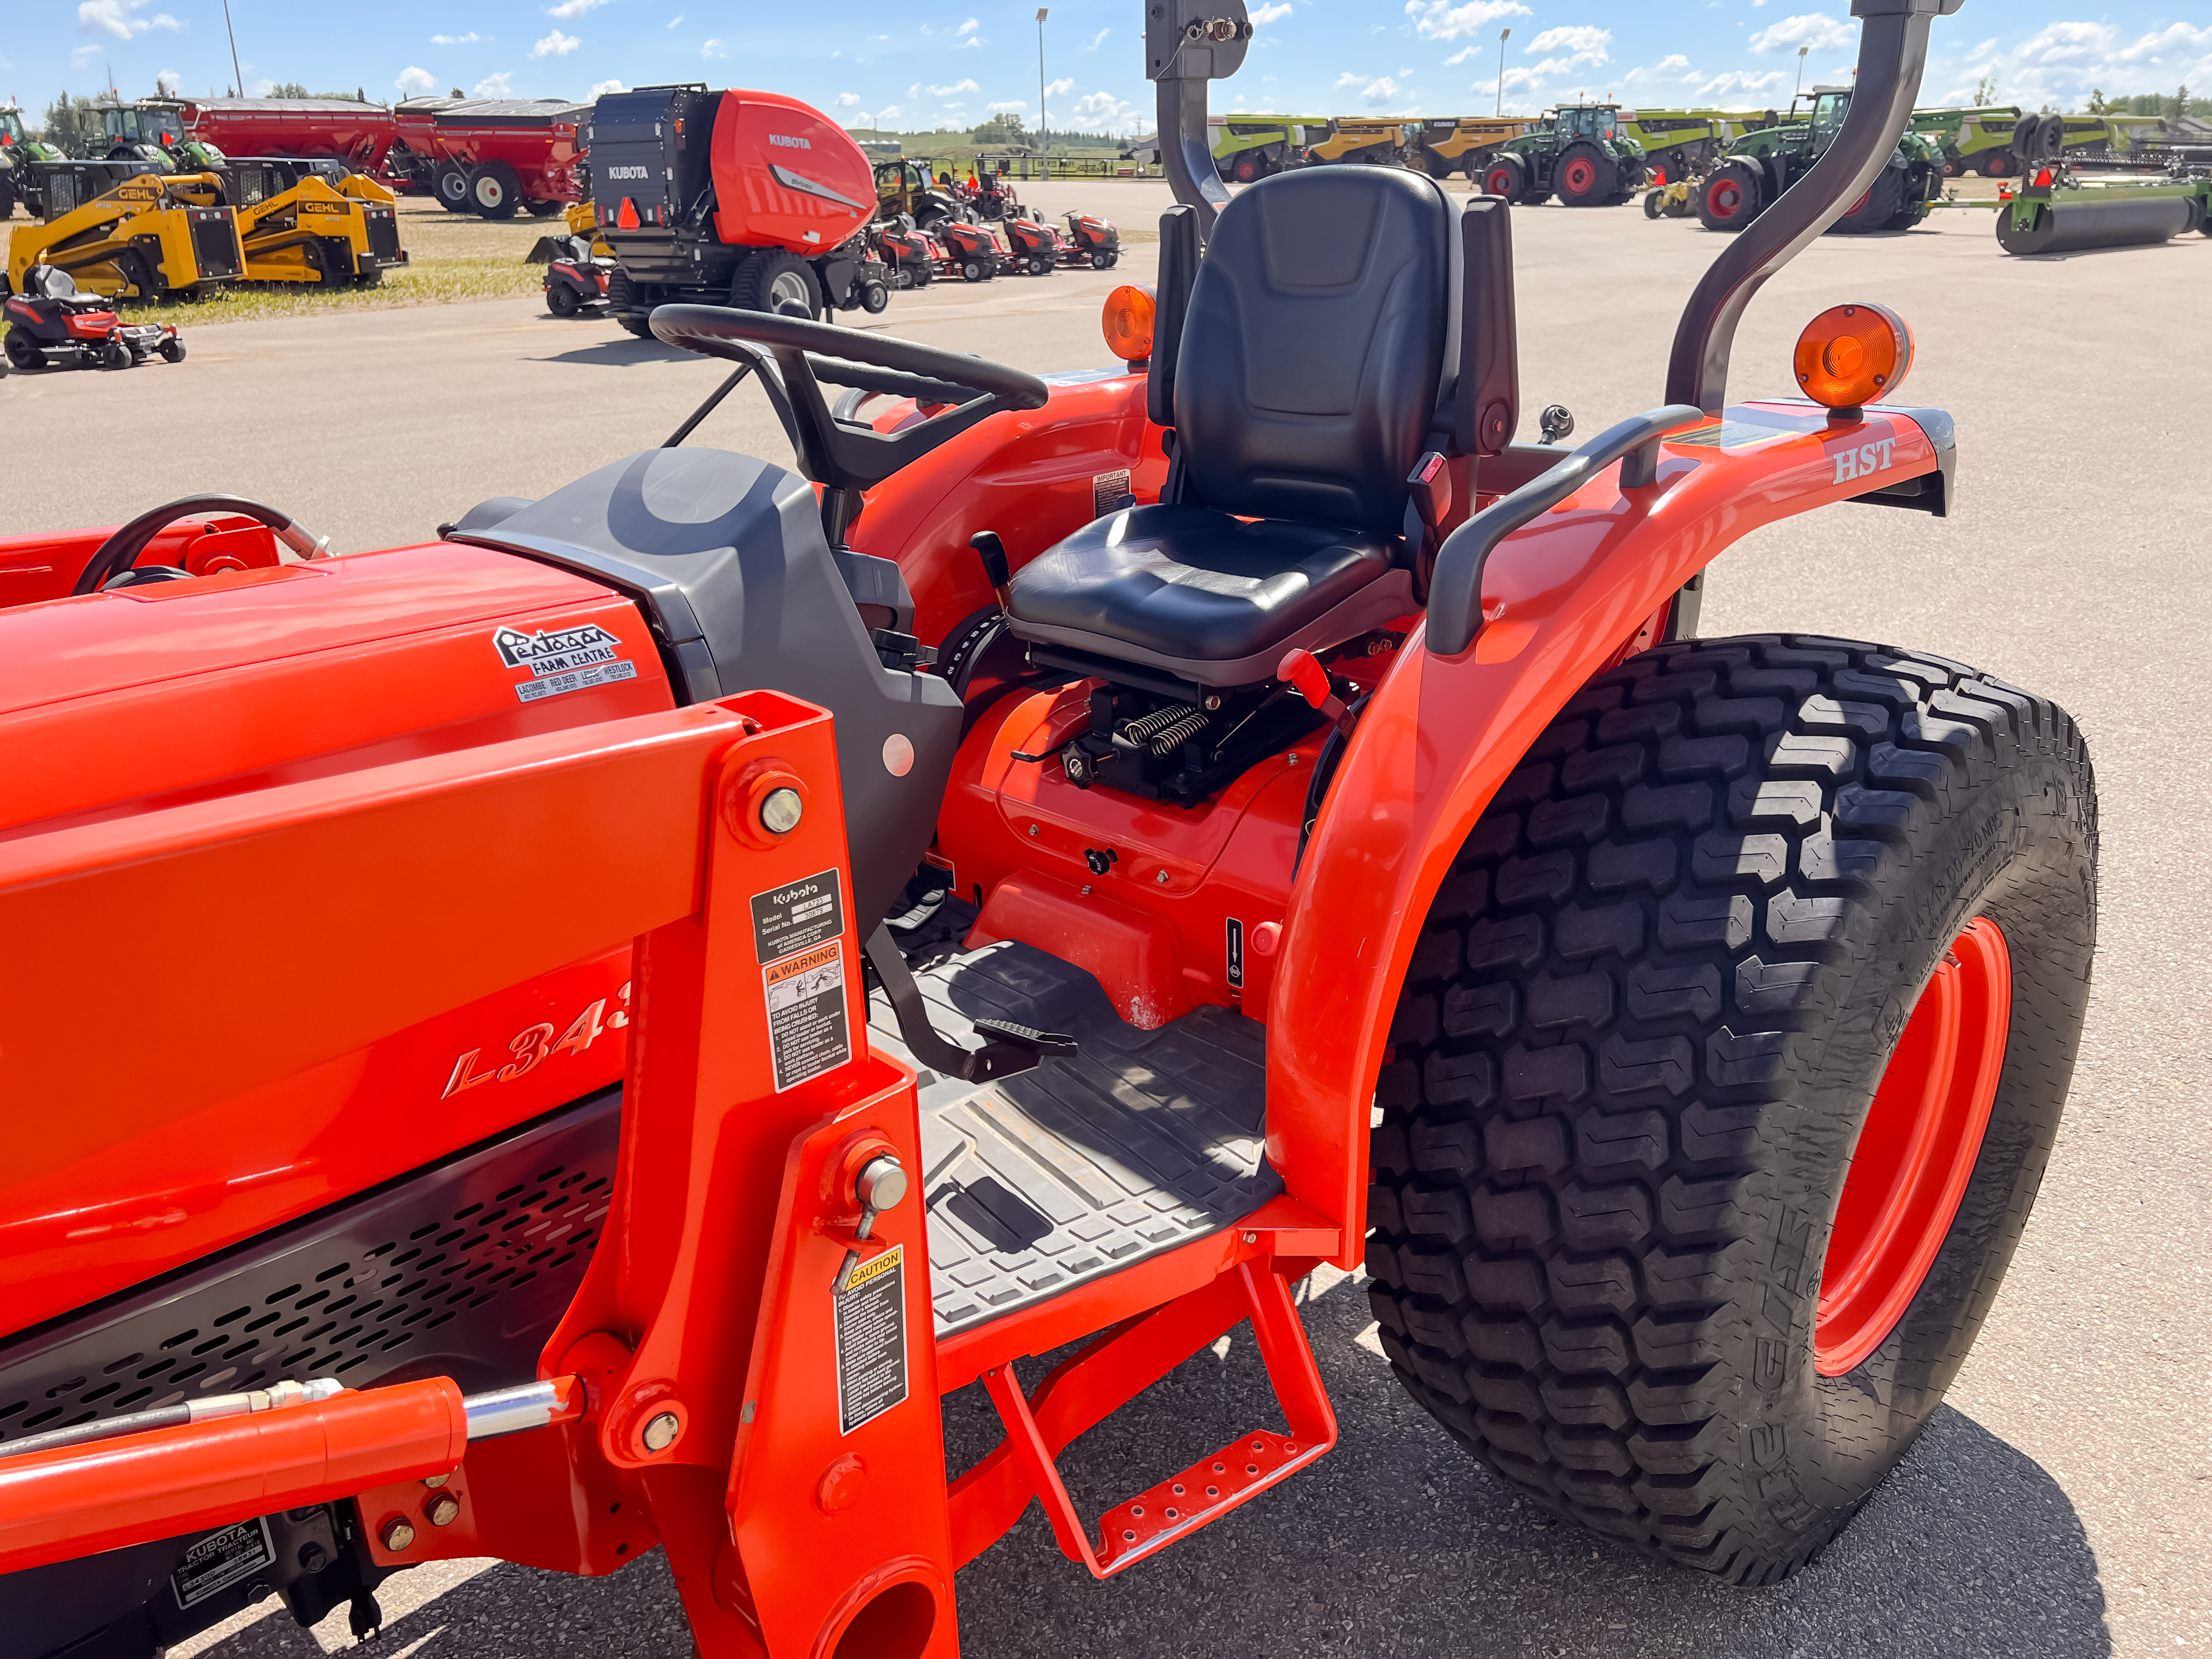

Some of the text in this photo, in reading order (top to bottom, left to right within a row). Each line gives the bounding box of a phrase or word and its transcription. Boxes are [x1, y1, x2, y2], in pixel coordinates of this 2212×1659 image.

[769, 134, 811, 149] KUBOTA
[608, 165, 648, 179] KUBOTA
[119, 189, 155, 199] GEHL
[253, 201, 279, 216] GEHL
[305, 202, 339, 213] GEHL
[1832, 437, 1896, 485] HST
[1097, 471, 1126, 482] IMPORTANT
[533, 648, 614, 675] FARM CENTRE
[947, 666, 955, 674] 2
[518, 681, 546, 695] LACOMBE
[550, 678, 562, 687] RED
[562, 674, 577, 685] DEER
[604, 663, 633, 675] WESTLOCK
[1975, 842, 1997, 869] SERVICE
[772, 881, 818, 907] Kubota
[761, 907, 823, 935] Serial No. 30879
[762, 897, 823, 925] Model LA723
[768, 918, 832, 946] KUBOTA MANUFACTURING
[783, 934, 806, 946] AMERICA
[781, 946, 837, 975] WARNING
[772, 996, 818, 1020] TO AVOID INJURY
[772, 1005, 816, 1028] FROM FALLS OR
[774, 1012, 818, 1035] BEING CRUSHED:
[789, 1026, 799, 1035] NOT
[790, 1038, 800, 1046] NOT
[791, 1049, 801, 1057] NOT
[785, 1061, 800, 1072] NEVER
[850, 1252, 898, 1285] CAUTION
[847, 1283, 864, 1296] AVOID
[865, 1266, 896, 1286] PERSONAL
[838, 1291, 861, 1307] INJURY:
[177, 1530, 258, 1573] TRACTOR TRACTEUR
[186, 1526, 247, 1562] KUBOTA
[196, 1562, 257, 1596] KUBOTA Corporation
